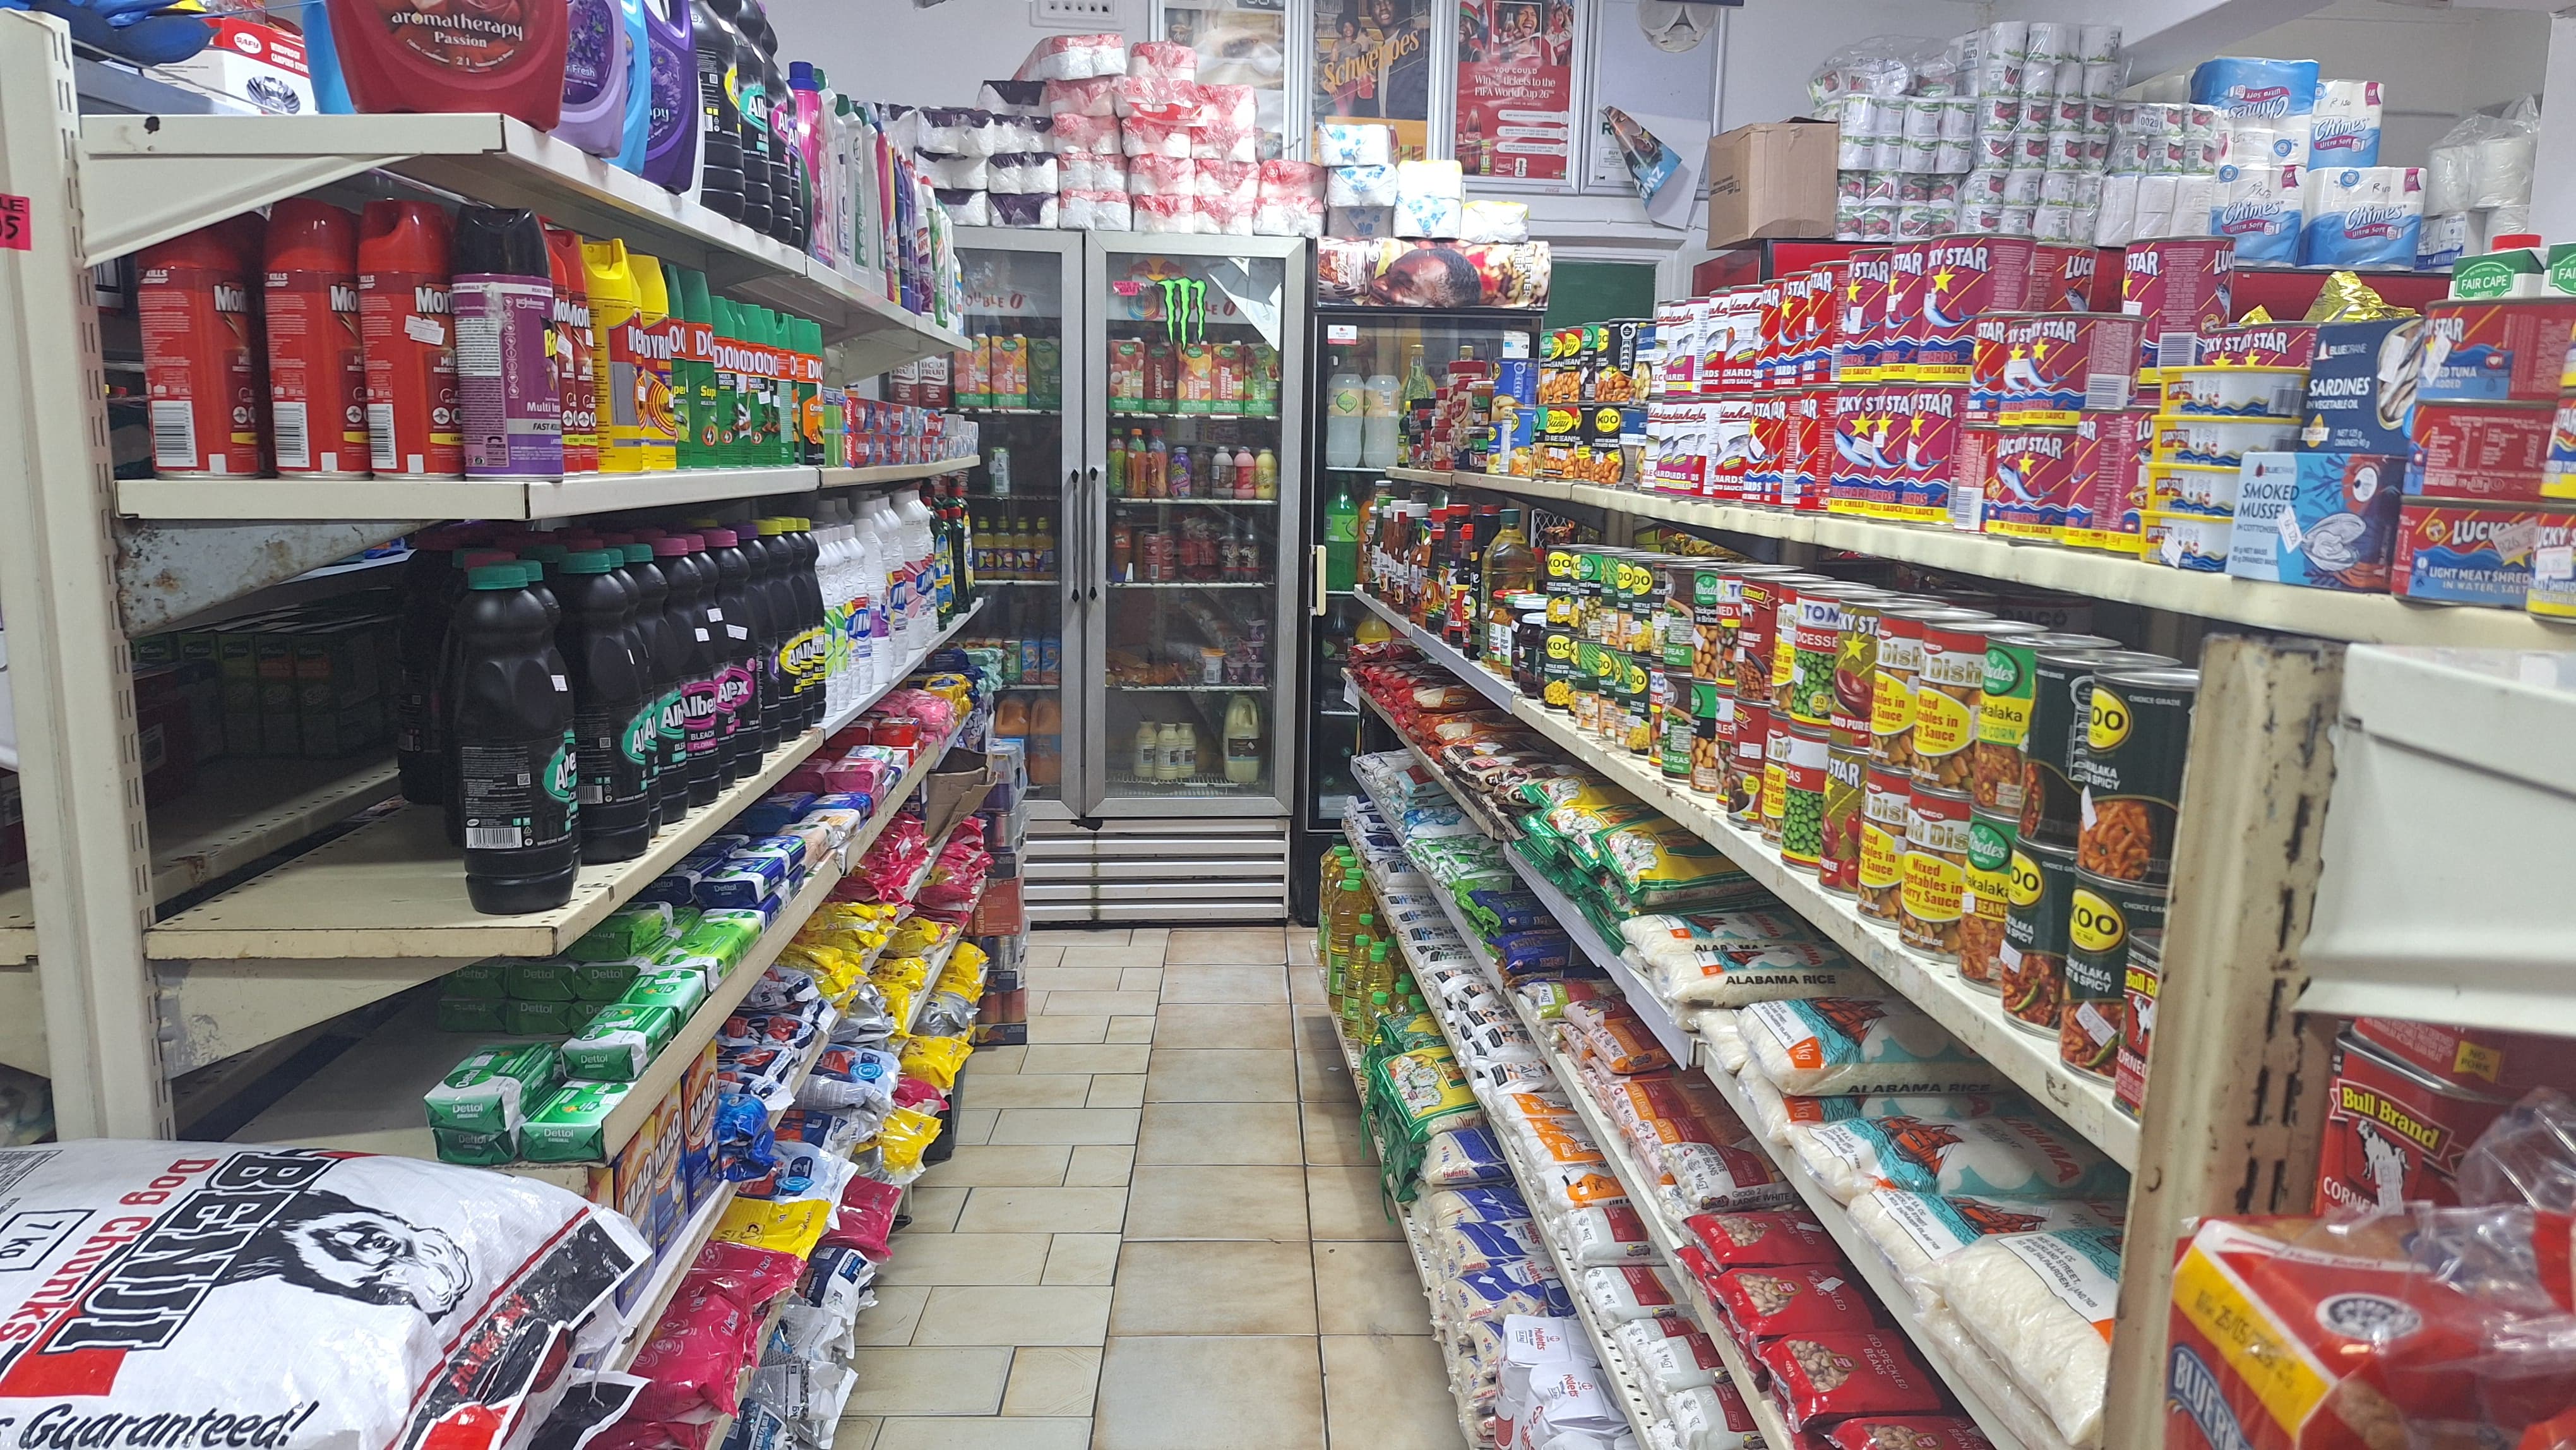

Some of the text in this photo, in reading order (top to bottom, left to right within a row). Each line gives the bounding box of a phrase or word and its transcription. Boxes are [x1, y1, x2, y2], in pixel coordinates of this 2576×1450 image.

[391, 11, 523, 41] aromatherapy
[434, 32, 487, 48] Passion
[572, 65, 596, 78] Fresh
[1475, 75, 1556, 87] Win tickets to the
[1475, 87, 1537, 100] FIFA World Cup
[2228, 96, 2289, 121] Chimes
[2314, 118, 2366, 141] Chimes
[2320, 138, 2352, 149] Ultra Soft
[2222, 201, 2281, 225] Chimes
[2344, 204, 2402, 231] Chimes
[2229, 224, 2247, 233] Ultra
[2352, 225, 2385, 238] Ultra Soft
[1945, 246, 1989, 273] STAR
[1854, 261, 1889, 283] STAR
[2462, 274, 2508, 291] FAIR CAPE
[2042, 321, 2077, 344] STAR
[2252, 332, 2288, 356] STAR
[2451, 366, 2478, 378] TUNA
[2308, 377, 2371, 397] SARDINES
[527, 402, 551, 412] Multi
[844, 399, 853, 425] Colgate
[1917, 393, 1954, 419] STAR
[2315, 399, 2346, 410] VEGETABLE
[2346, 400, 2359, 409] OIL
[534, 423, 550, 431] FAST
[1597, 415, 1618, 424] KOO
[845, 435, 853, 461] Colgate
[2030, 437, 2063, 460] STAR
[2242, 483, 2300, 501] SMOKED
[2239, 503, 2296, 520] MUSSE
[1547, 558, 1571, 568] KOO
[2429, 566, 2458, 579] LIGHT
[2462, 569, 2491, 582] MEAT
[2443, 580, 2454, 589] IN
[2501, 584, 2526, 595] SALT
[1669, 647, 1686, 656] PEAS
[1935, 658, 1983, 683] Dish
[1879, 709, 1903, 722] Sauce
[1948, 715, 1958, 728] in
[690, 730, 715, 740] BLEACH
[1924, 729, 1955, 743] Sauce
[693, 740, 715, 750] FLORAL
[1669, 755, 1690, 764] PEAS
[2094, 776, 2121, 791] SPICY
[1968, 834, 2006, 858] Rhodes
[1911, 859, 1941, 878] Mixed
[713, 884, 737, 894] Dettol
[1953, 884, 1963, 894] in
[1923, 893, 1960, 910] Sauce
[977, 906, 985, 934] Red Bull
[1920, 935, 1944, 947] GRADE
[2008, 929, 2034, 945] SPICY
[523, 968, 555, 980] Dettol
[591, 967, 624, 980] Dettol
[1726, 974, 1836, 985] ALABAMA RICE
[2080, 976, 2111, 993] SPICY
[520, 1002, 553, 1015] Dettol
[580, 1053, 609, 1065] Dettol
[1794, 1042, 1811, 1061] 1kg
[2468, 1046, 2486, 1061] NO
[2459, 1053, 2491, 1075] PORK
[1847, 1082, 1991, 1094] ALABAMA RICE
[452, 1101, 484, 1114] Dettol
[689, 1072, 718, 1130] MAQ
[1793, 1100, 1809, 1118] 1kg
[2341, 1086, 2440, 1150] Bull Brand
[544, 1127, 575, 1139] Dettol
[654, 1110, 683, 1168] MAQ
[120, 1158, 219, 1206] Dog
[1443, 1170, 1469, 1178] Huletts
[623, 1149, 653, 1216] MAQ
[1732, 1189, 1756, 1199] Grade
[1763, 1193, 1790, 1202] WHITE
[1524, 1221, 1541, 1245] Huletts
[0, 1216, 153, 1344] Chunks
[1534, 1327, 1546, 1351] Huletts
[1865, 1346, 1887, 1377] BEANS
[1867, 1333, 1909, 1392] RED SPECKLED
[19, 1399, 319, 1450] Guaranteed!
